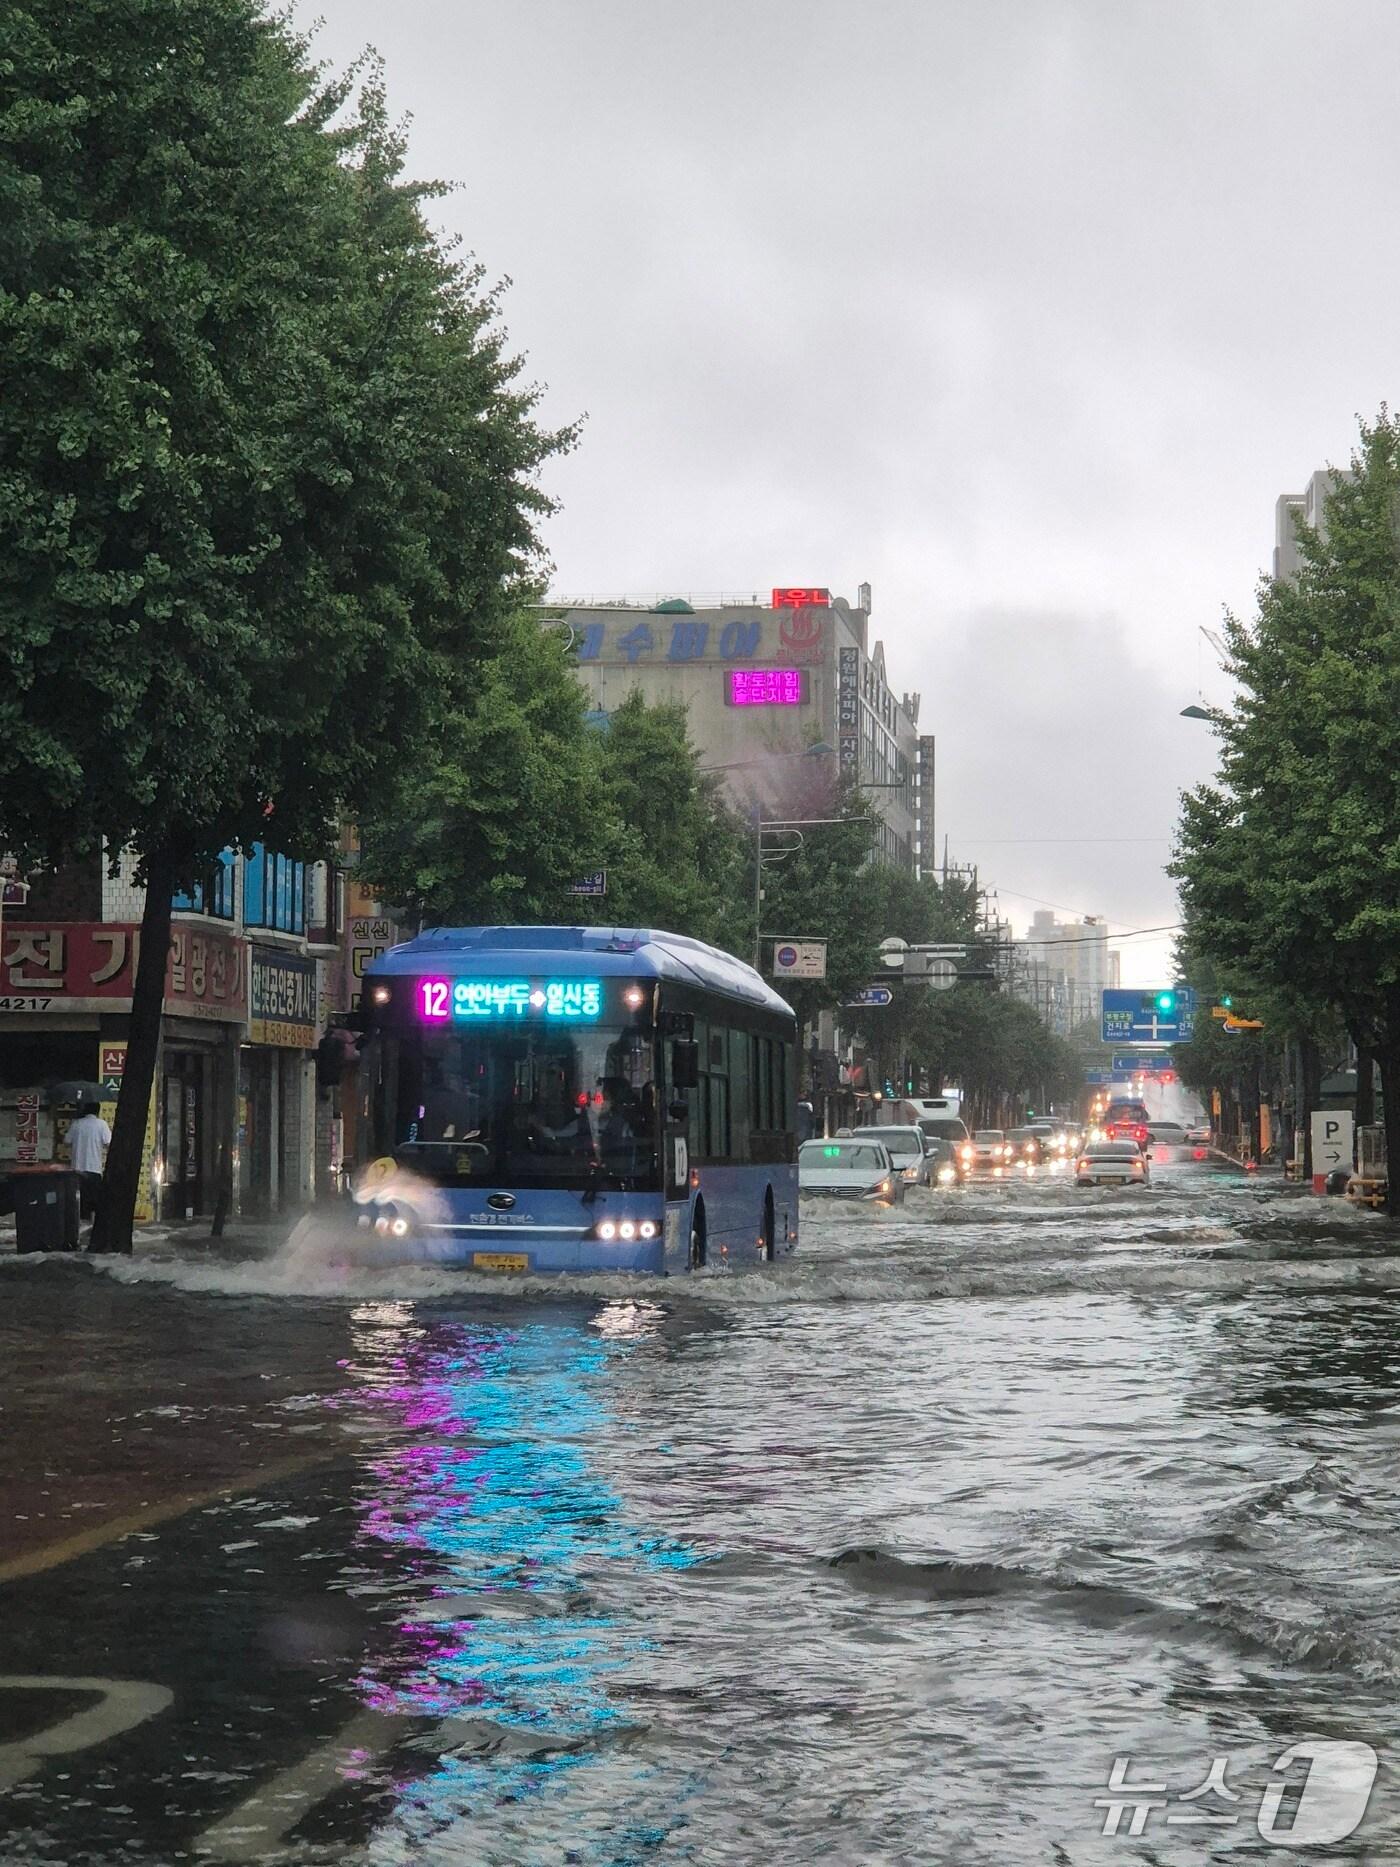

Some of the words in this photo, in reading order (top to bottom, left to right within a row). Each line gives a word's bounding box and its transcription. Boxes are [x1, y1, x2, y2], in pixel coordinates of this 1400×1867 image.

[352, 921, 389, 939] 신신
[0, 998, 52, 1010] 4217
[422, 982, 448, 1016] 12
[454, 983, 529, 1015] 연안부두
[546, 983, 600, 1016] 일신동
[1326, 1121, 1339, 1139] P
